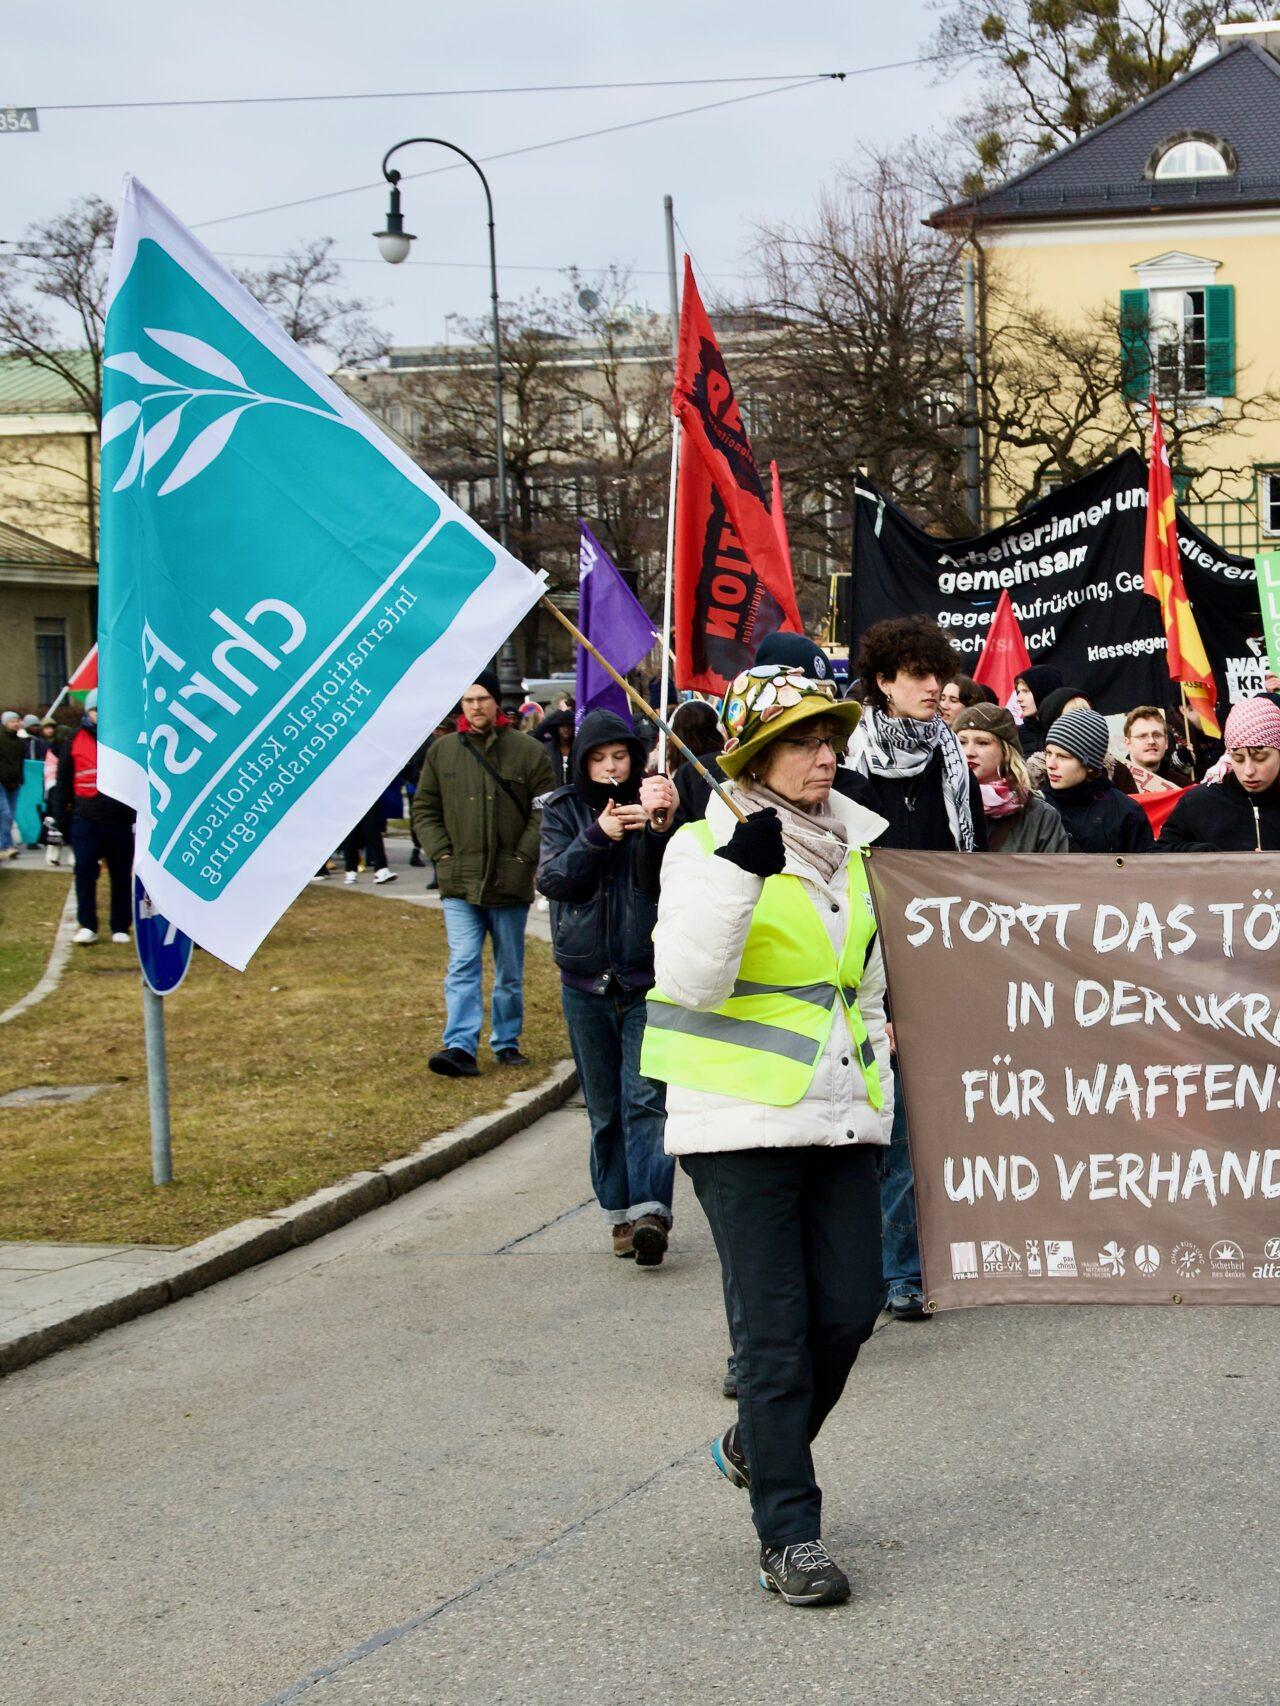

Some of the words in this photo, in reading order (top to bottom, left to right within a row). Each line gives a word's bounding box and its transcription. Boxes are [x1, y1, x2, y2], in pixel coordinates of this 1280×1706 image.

[1115, 487, 1149, 512] un
[1115, 571, 1145, 593] Ge
[1237, 675, 1263, 690] KR
[905, 897, 1081, 950] STOPPT
[1093, 904, 1197, 960] DAS
[1007, 982, 1055, 1032] IN
[1075, 980, 1182, 1033] DER
[961, 1054, 1055, 1123] FÜR
[943, 1155, 1040, 1206] UND
[983, 1261, 1022, 1272] DFG-VK
